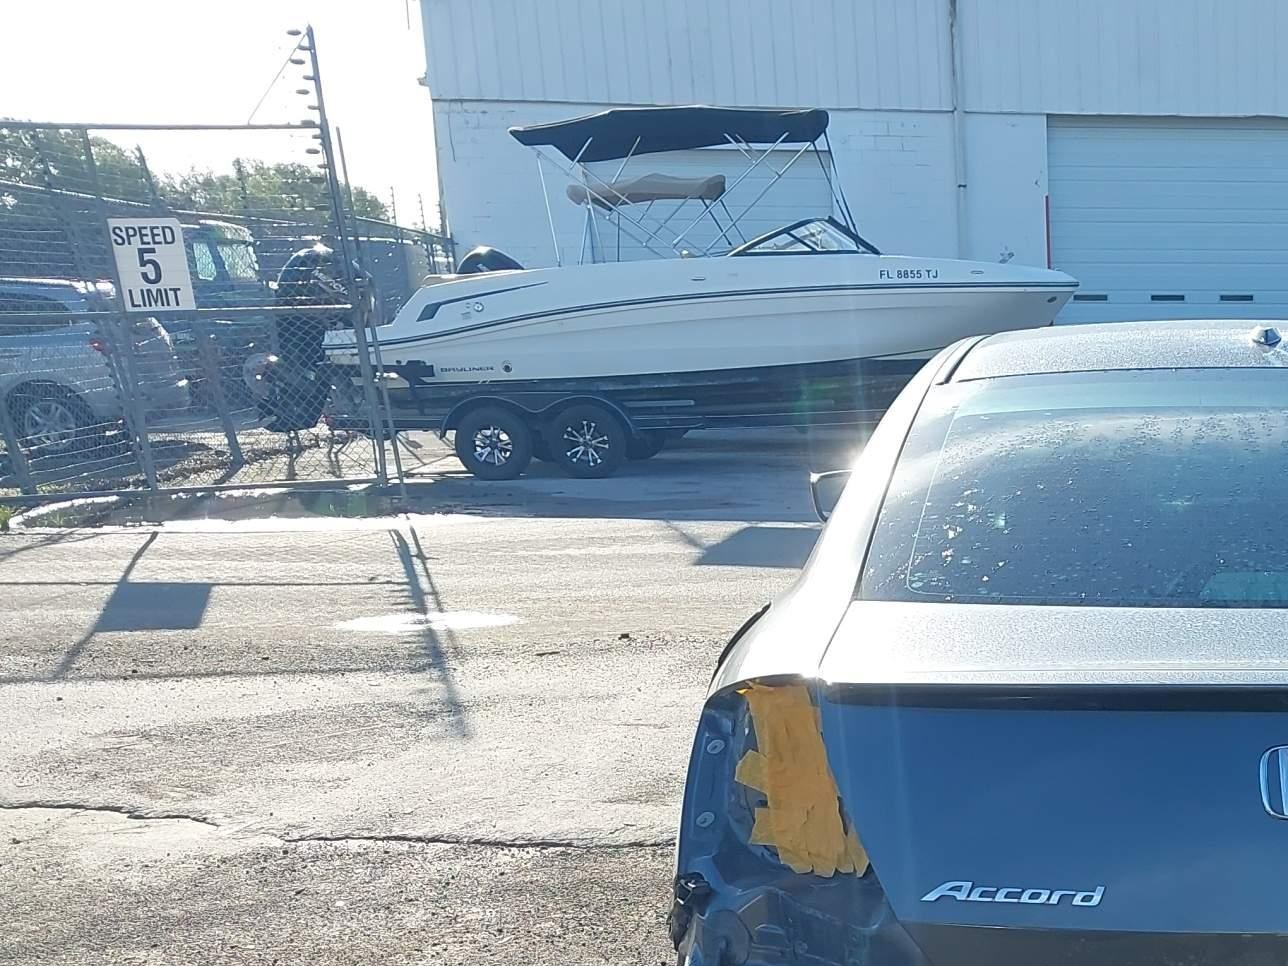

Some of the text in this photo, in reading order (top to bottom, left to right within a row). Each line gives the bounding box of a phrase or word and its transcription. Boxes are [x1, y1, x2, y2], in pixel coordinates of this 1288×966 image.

[112, 225, 176, 246] SPEED
[137, 247, 162, 285] 5
[879, 269, 939, 280] FL 8855 TJ
[128, 287, 181, 308] LIMIT
[919, 881, 1105, 907] Accord
